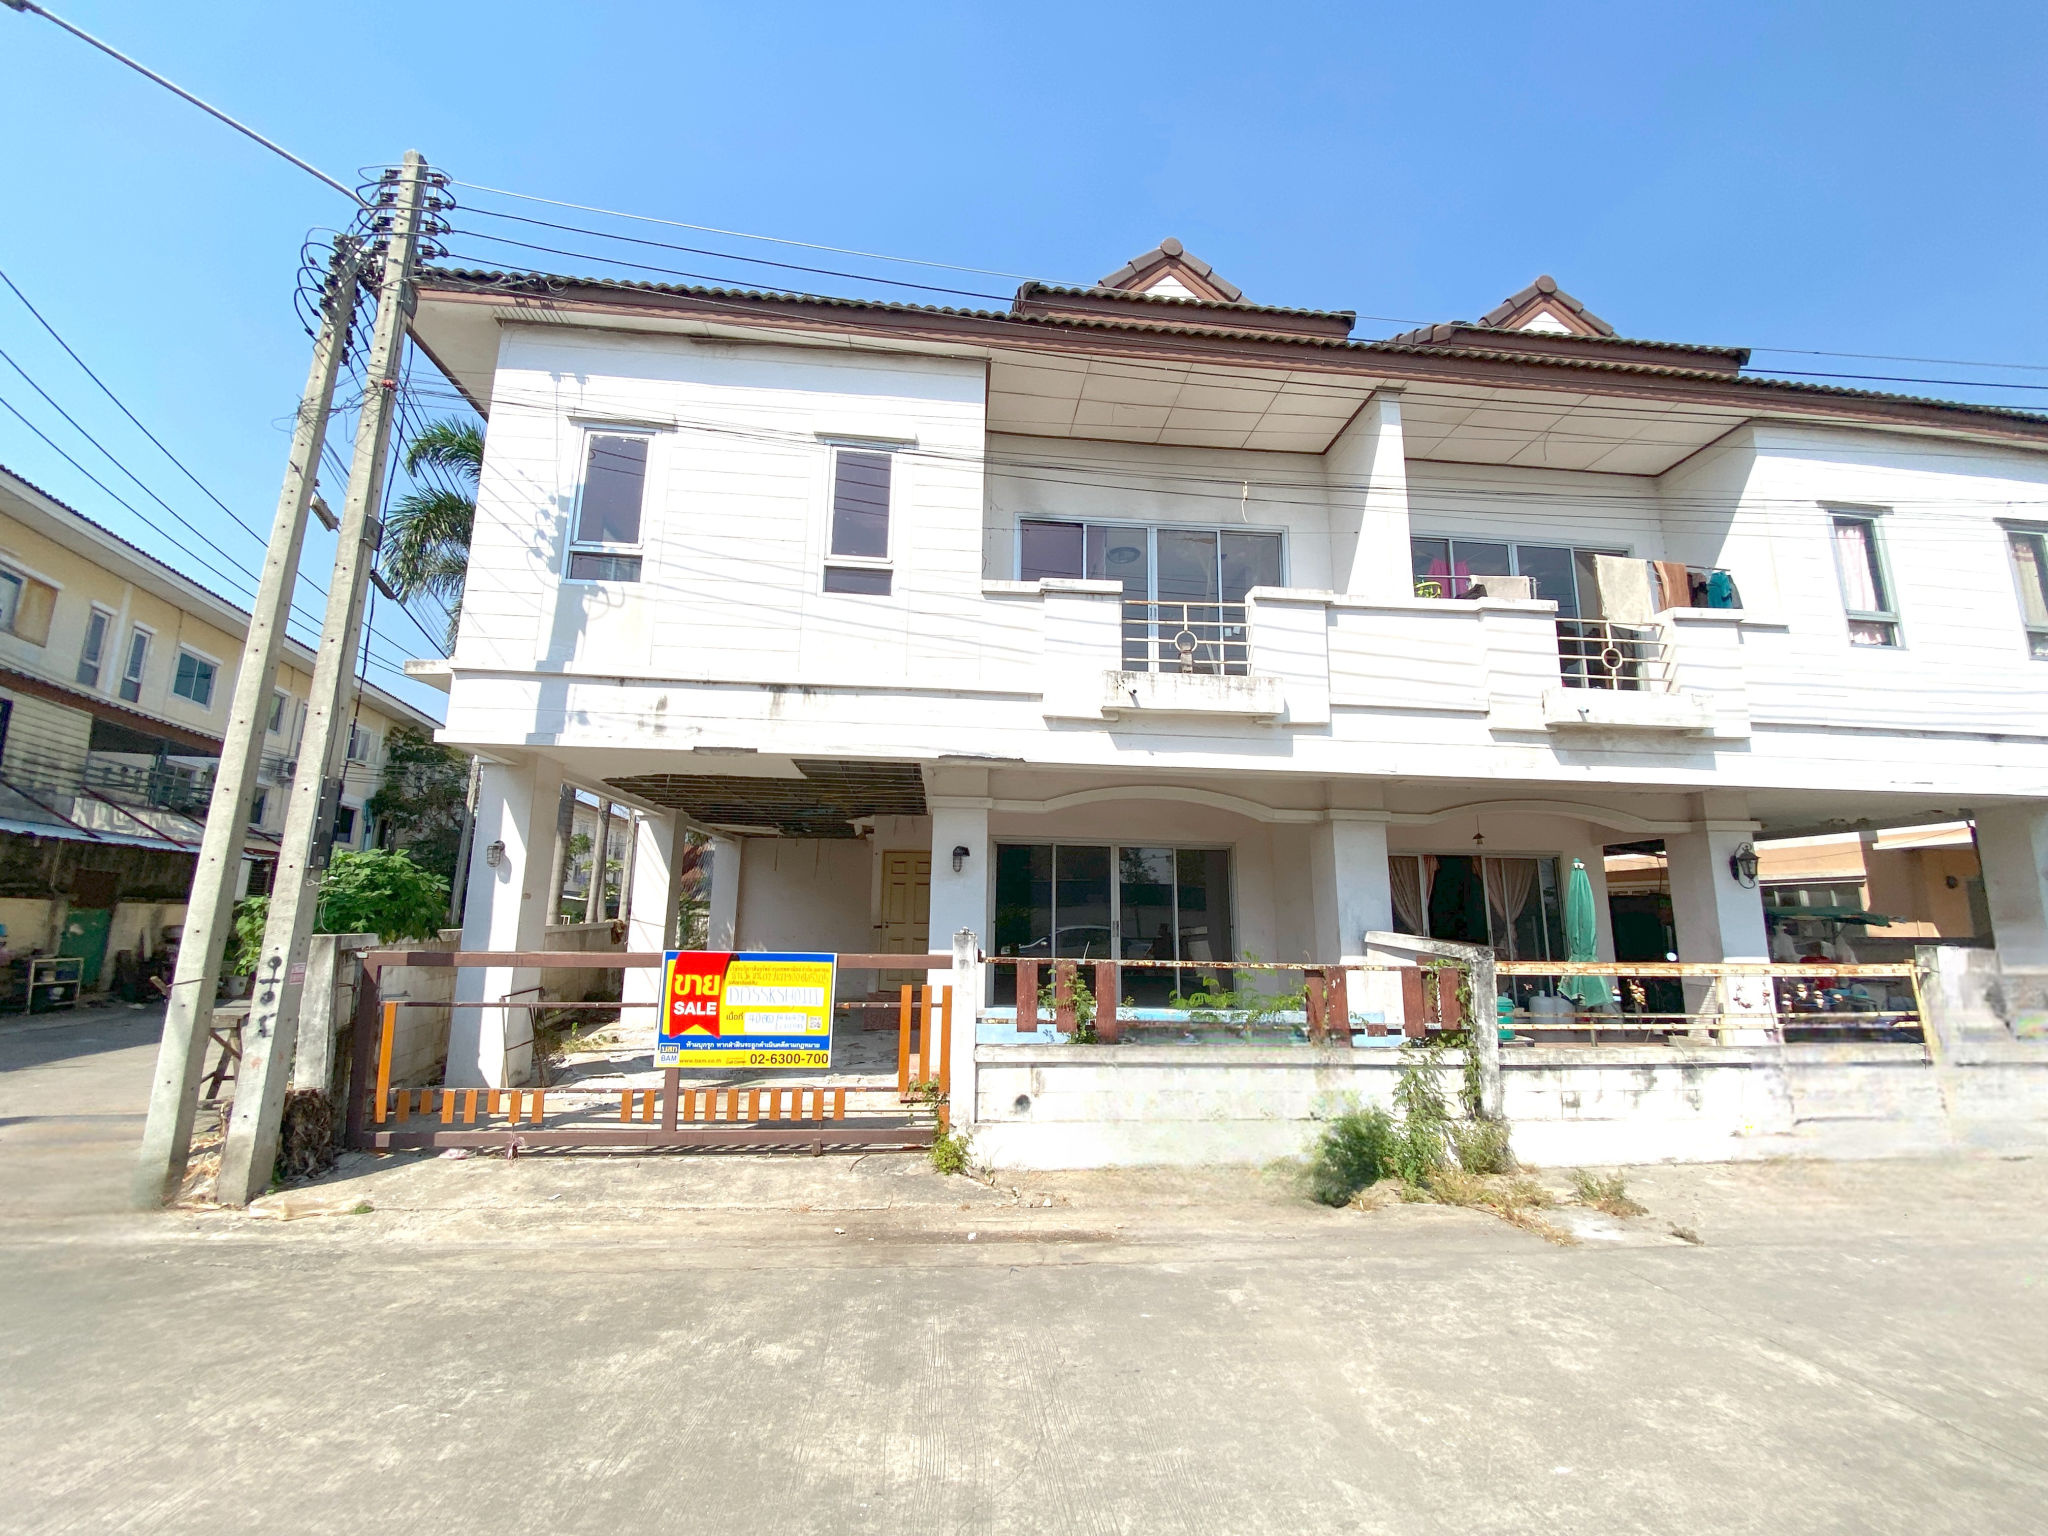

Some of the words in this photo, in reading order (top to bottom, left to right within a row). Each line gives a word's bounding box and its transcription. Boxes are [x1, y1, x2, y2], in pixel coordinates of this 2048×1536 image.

[674, 974, 721, 996] ขาย
[673, 1001, 717, 1015] SALE
[660, 1054, 677, 1062] BAM
[750, 1053, 829, 1065] 02-6300-700
